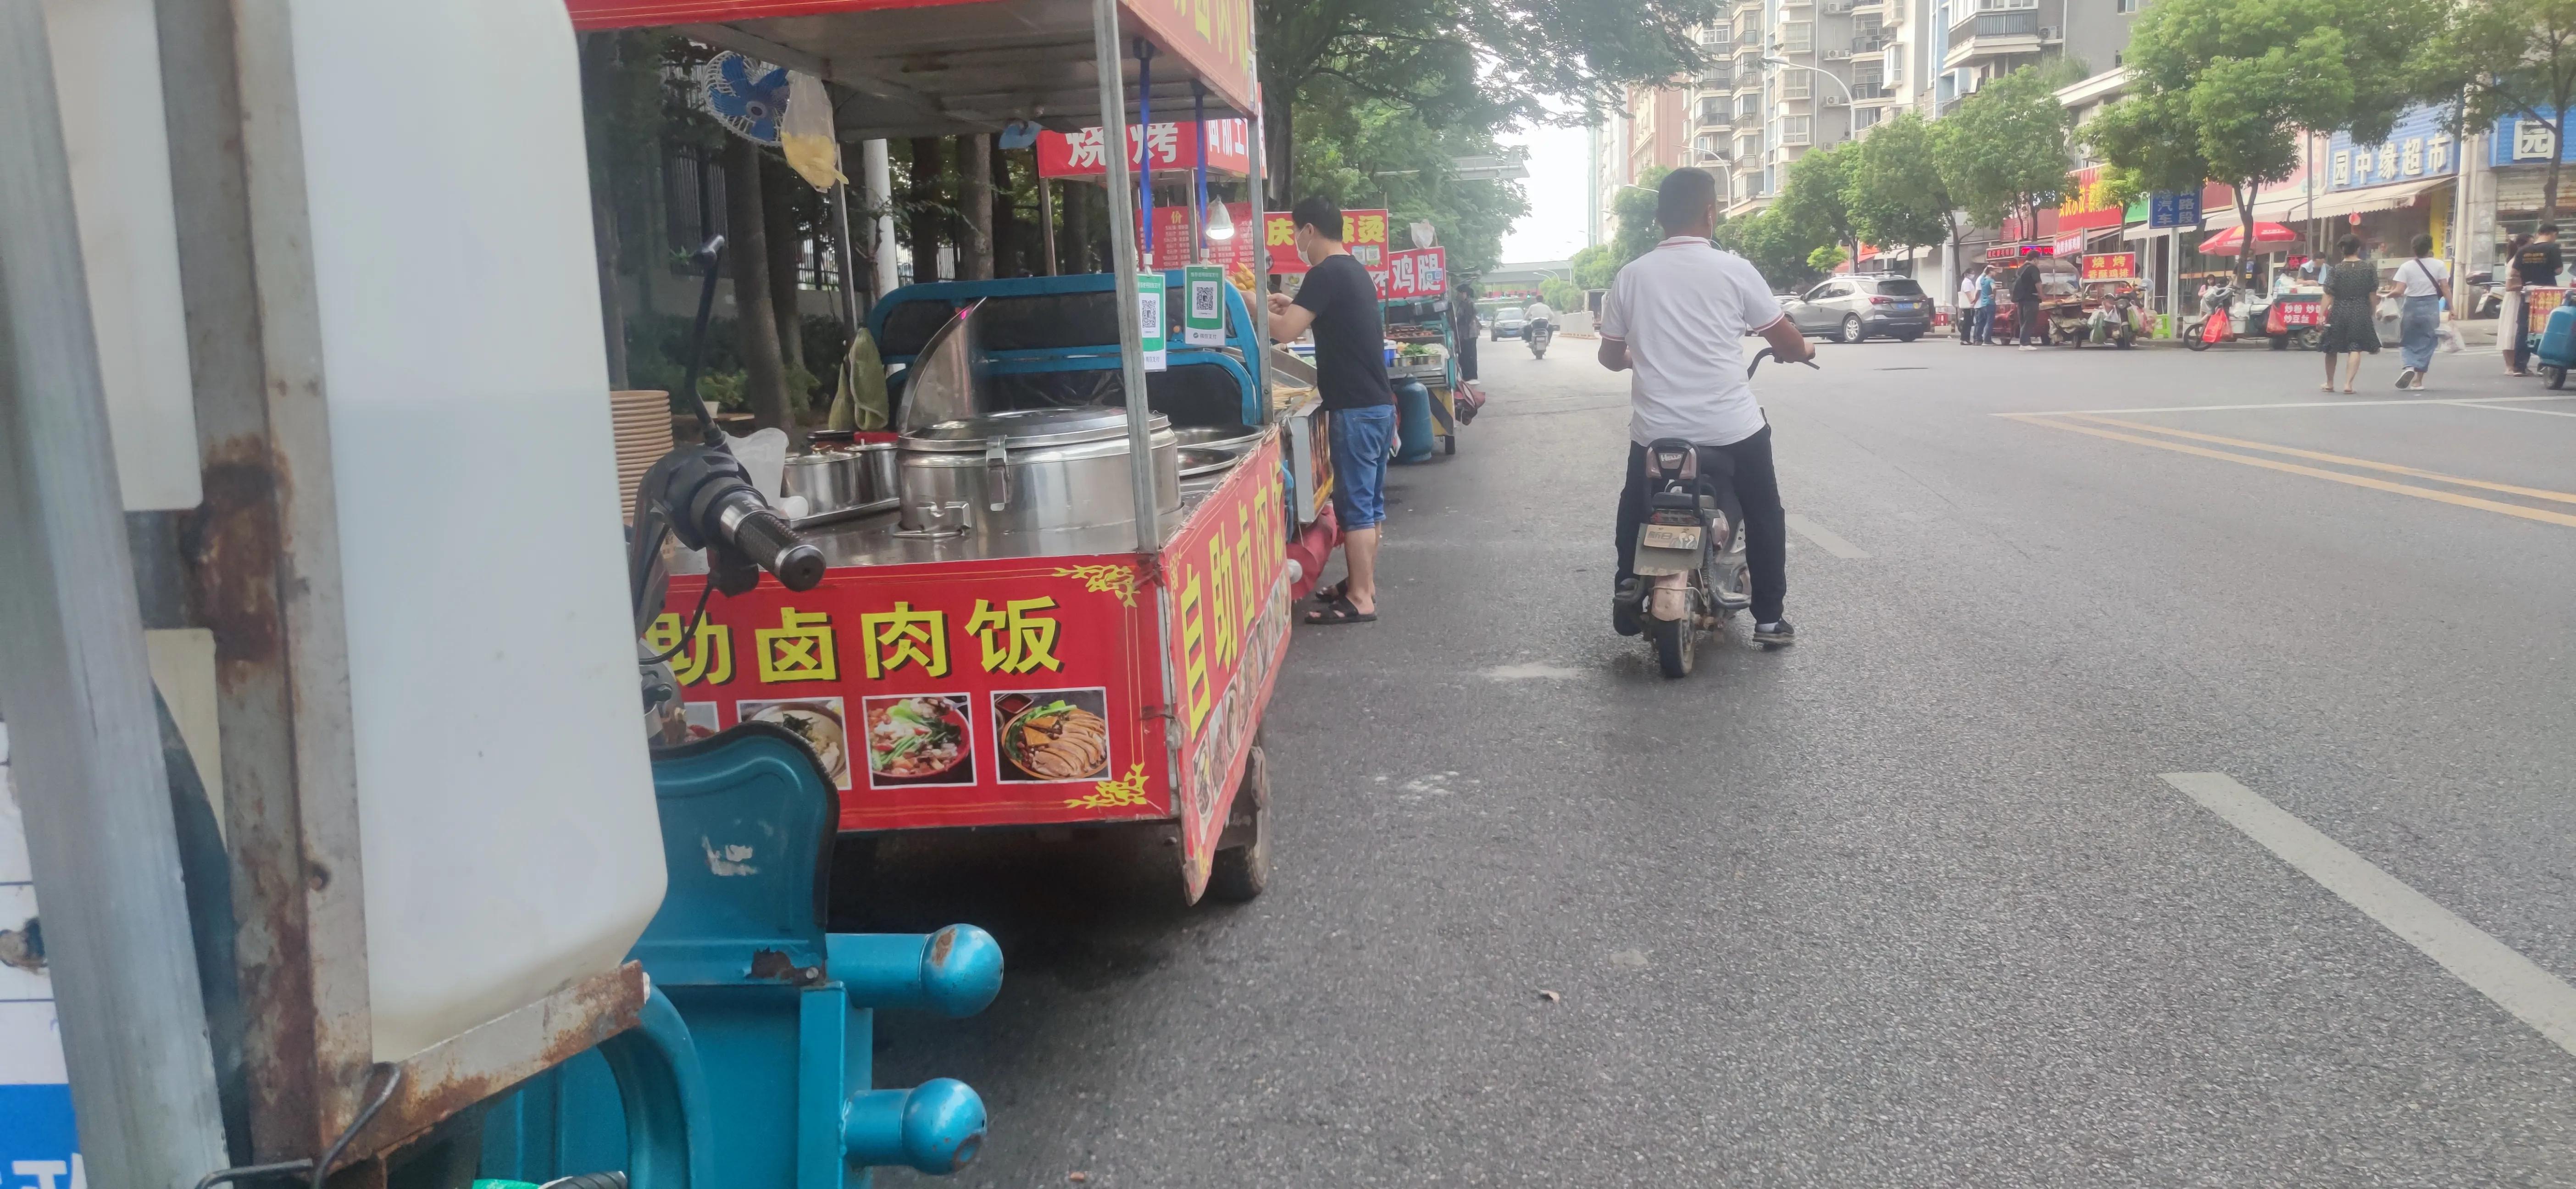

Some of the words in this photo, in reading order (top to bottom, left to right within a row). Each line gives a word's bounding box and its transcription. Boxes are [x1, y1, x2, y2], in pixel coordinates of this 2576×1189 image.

[1065, 122, 1178, 168] 烧烤
[2333, 133, 2450, 186] 园中缘超市
[2513, 119, 2556, 160] 园
[2178, 191, 2195, 224] 路段
[1180, 457, 1283, 743] 自助卤肉饭
[645, 595, 1063, 687] 助卤肉饭
